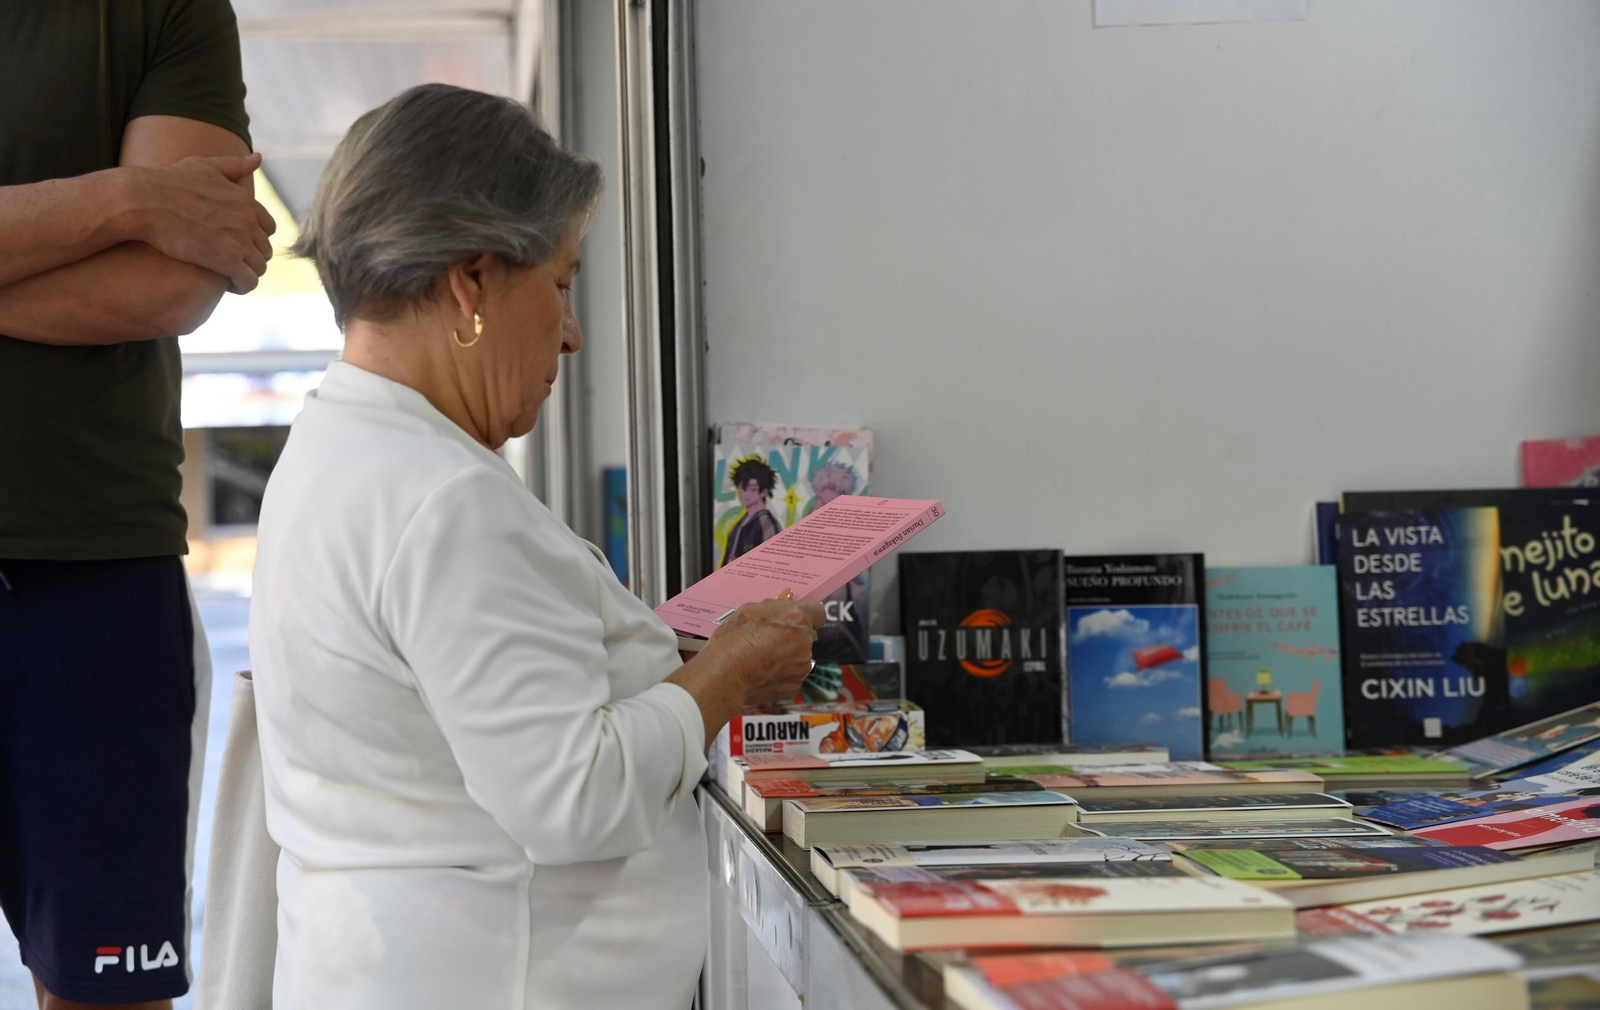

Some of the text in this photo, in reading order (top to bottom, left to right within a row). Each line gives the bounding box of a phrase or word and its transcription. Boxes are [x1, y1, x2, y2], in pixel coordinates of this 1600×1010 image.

[930, 506, 940, 518] 30
[902, 518, 925, 534] Durian
[1352, 525, 1444, 548] LA VISTA
[873, 532, 904, 557] Sukegawa
[1500, 515, 1595, 573] nejito
[1353, 552, 1423, 574] DESDE
[1111, 574, 1183, 587] PROFUNDO
[1355, 580, 1396, 601] LAS
[1206, 607, 1242, 619] NTES
[1503, 590, 1525, 617] e
[1357, 604, 1470, 628] ESTRELLAS
[917, 627, 1047, 662] UZUMAKI
[1360, 675, 1486, 700] CIXIN LIU
[744, 720, 810, 742] NARUTO
[94, 940, 179, 974] FILA
